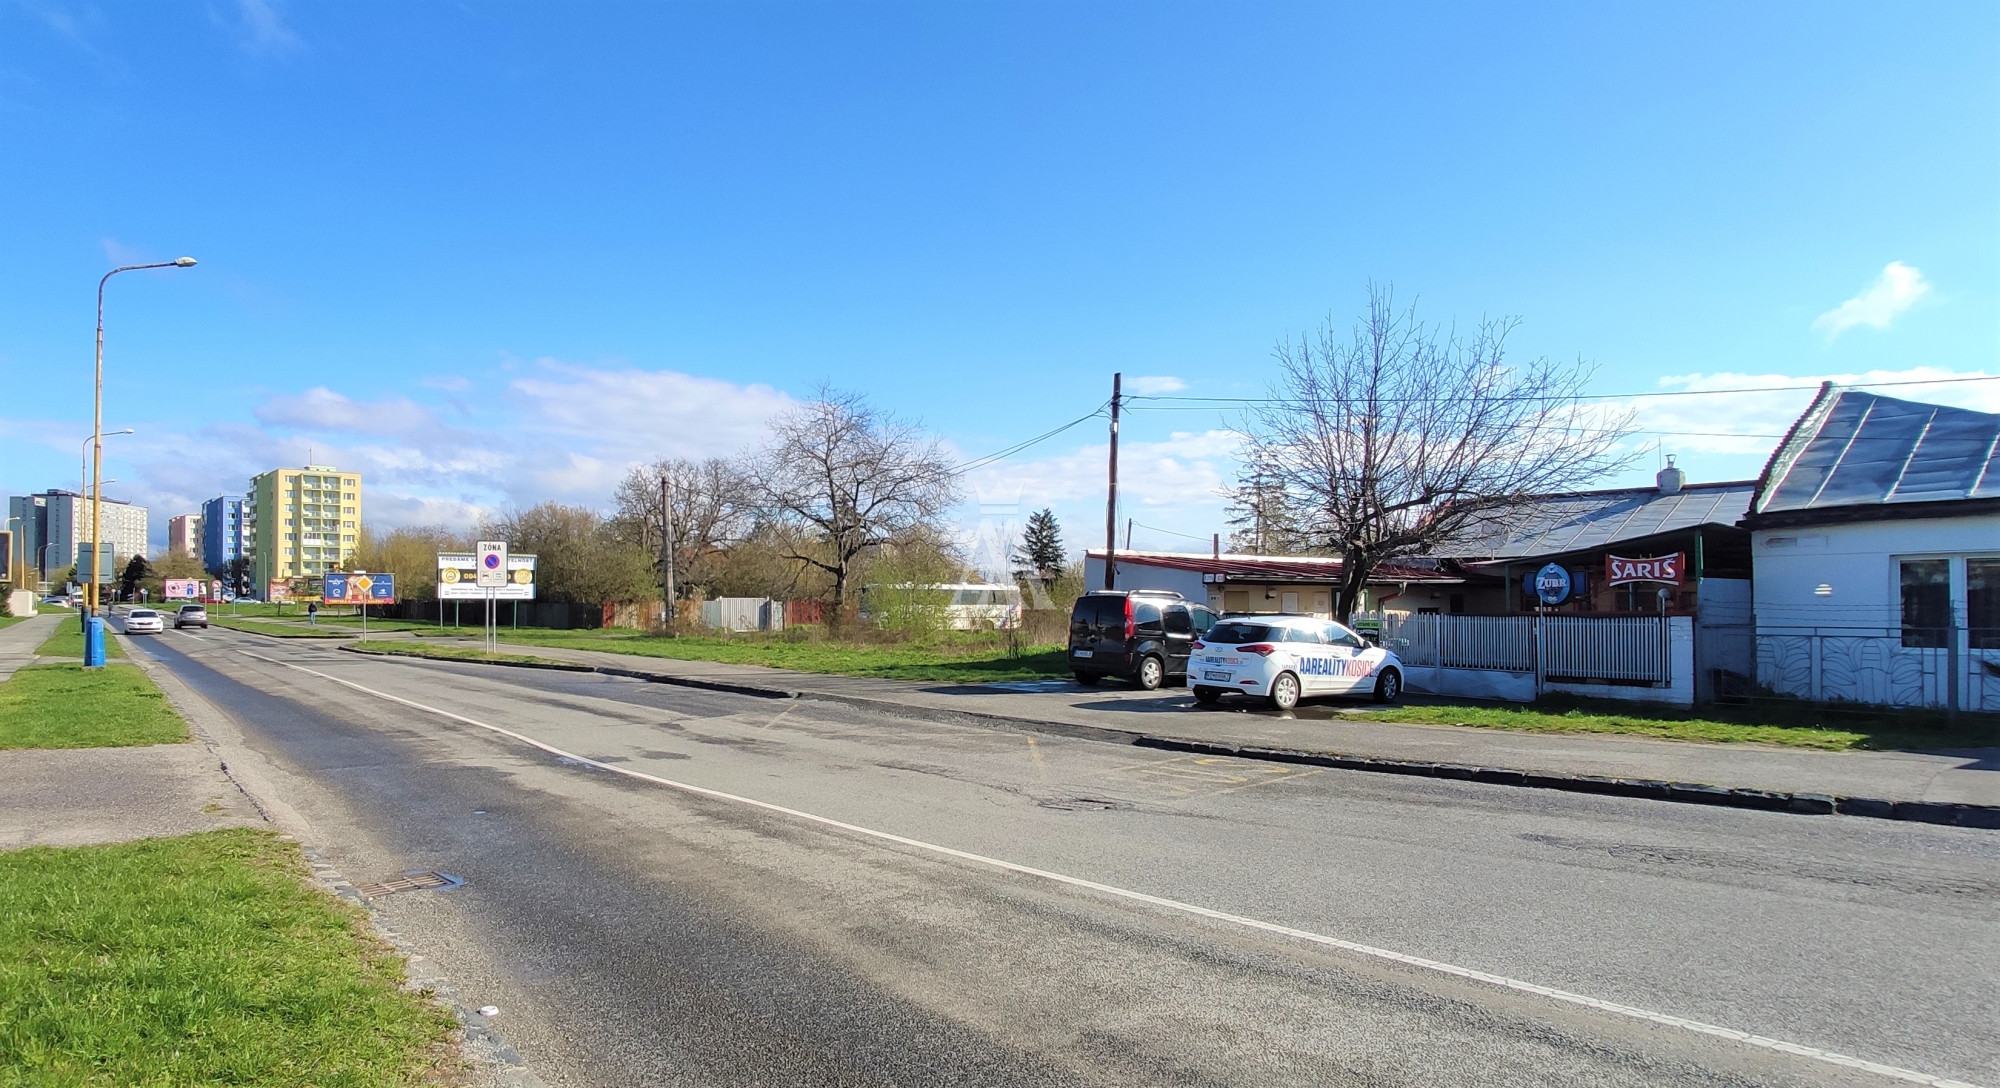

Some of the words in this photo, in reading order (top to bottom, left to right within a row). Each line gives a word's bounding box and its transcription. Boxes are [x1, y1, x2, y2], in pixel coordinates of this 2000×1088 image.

[483, 543, 502, 551] ZÓNA
[1611, 558, 1676, 579] ŠARIŠ
[1537, 577, 1568, 590] ZUBR
